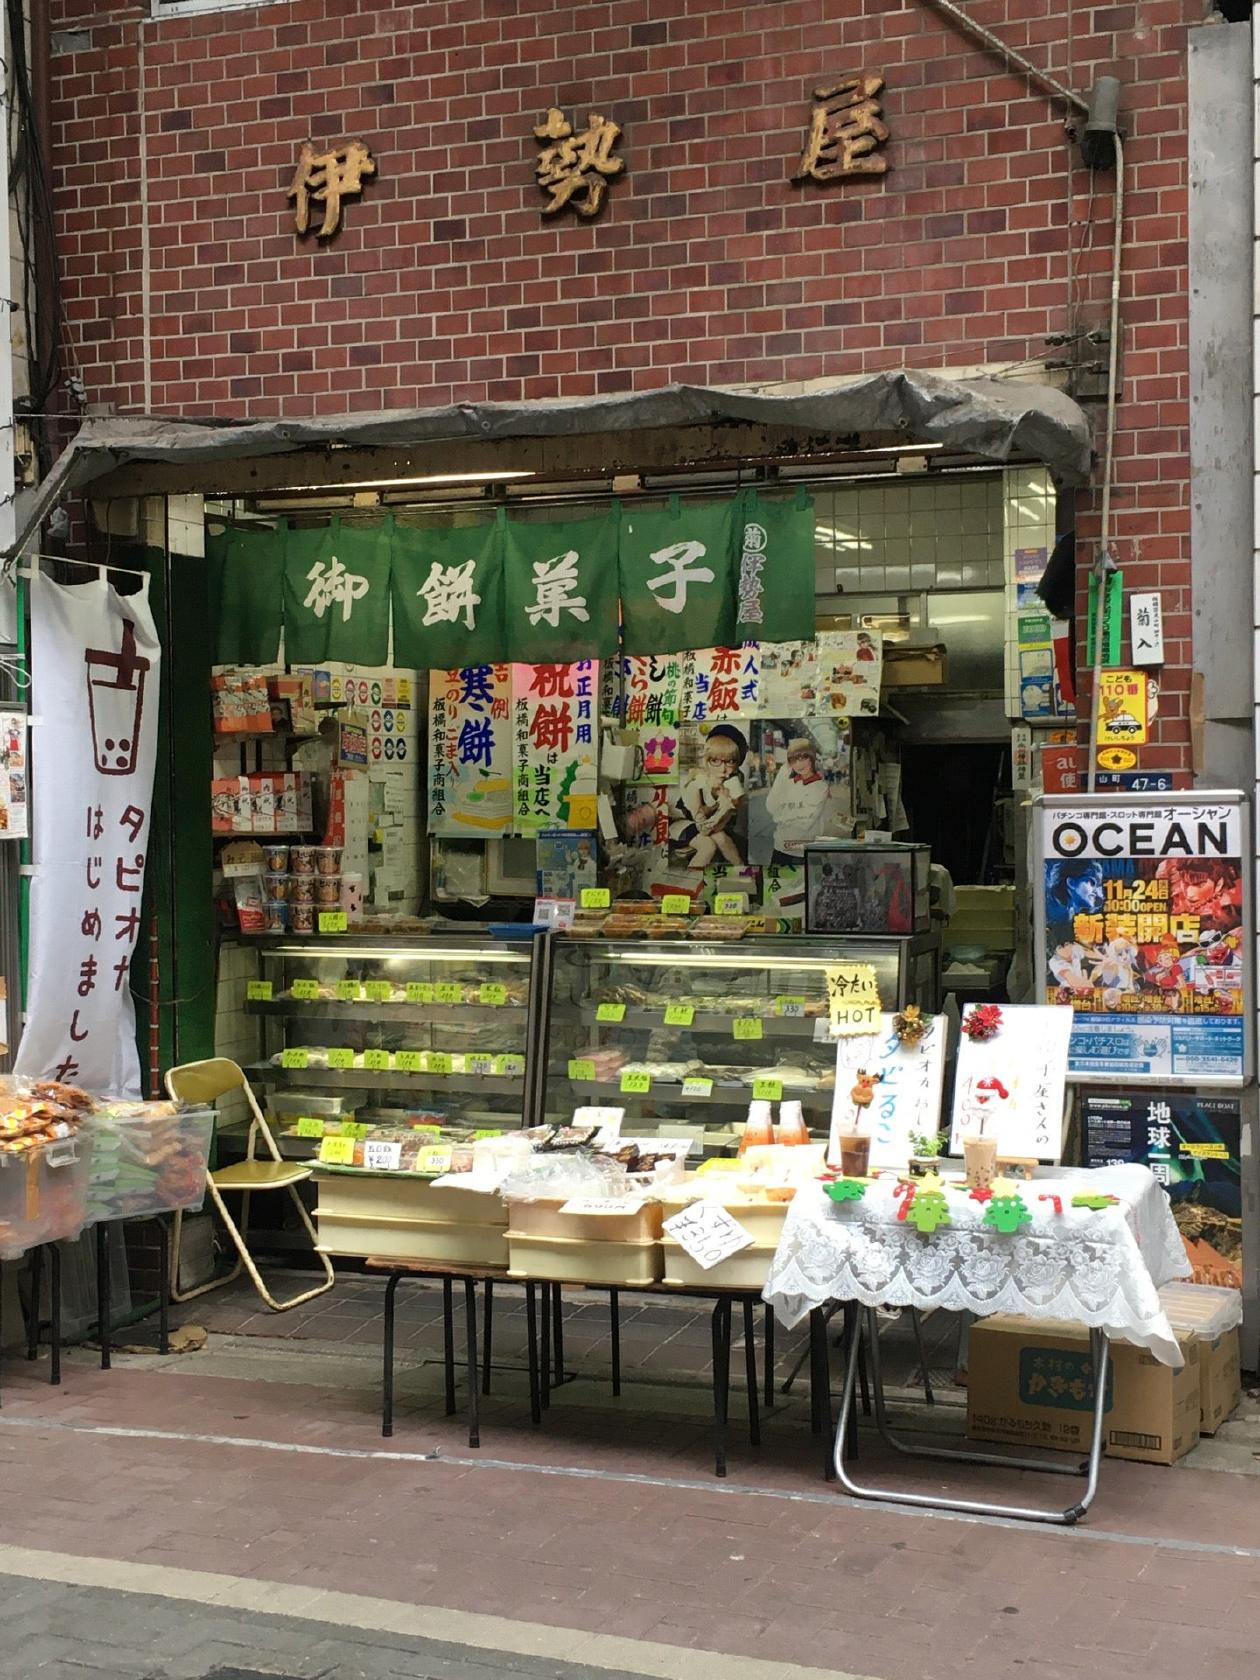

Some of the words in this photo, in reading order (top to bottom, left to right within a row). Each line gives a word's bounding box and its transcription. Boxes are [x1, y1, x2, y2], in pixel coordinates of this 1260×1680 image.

[692, 672, 709, 720] 当店
[707, 647, 741, 713] 赤飯
[1105, 675, 1132, 684] こども
[1131, 778, 1166, 791] 47-6
[1053, 822, 1228, 857] OCEAN
[57, 804, 104, 1085] はじめました
[831, 973, 874, 998] 冷たい
[836, 1008, 875, 1026] HOT
[1148, 1101, 1171, 1204] 地球一周
